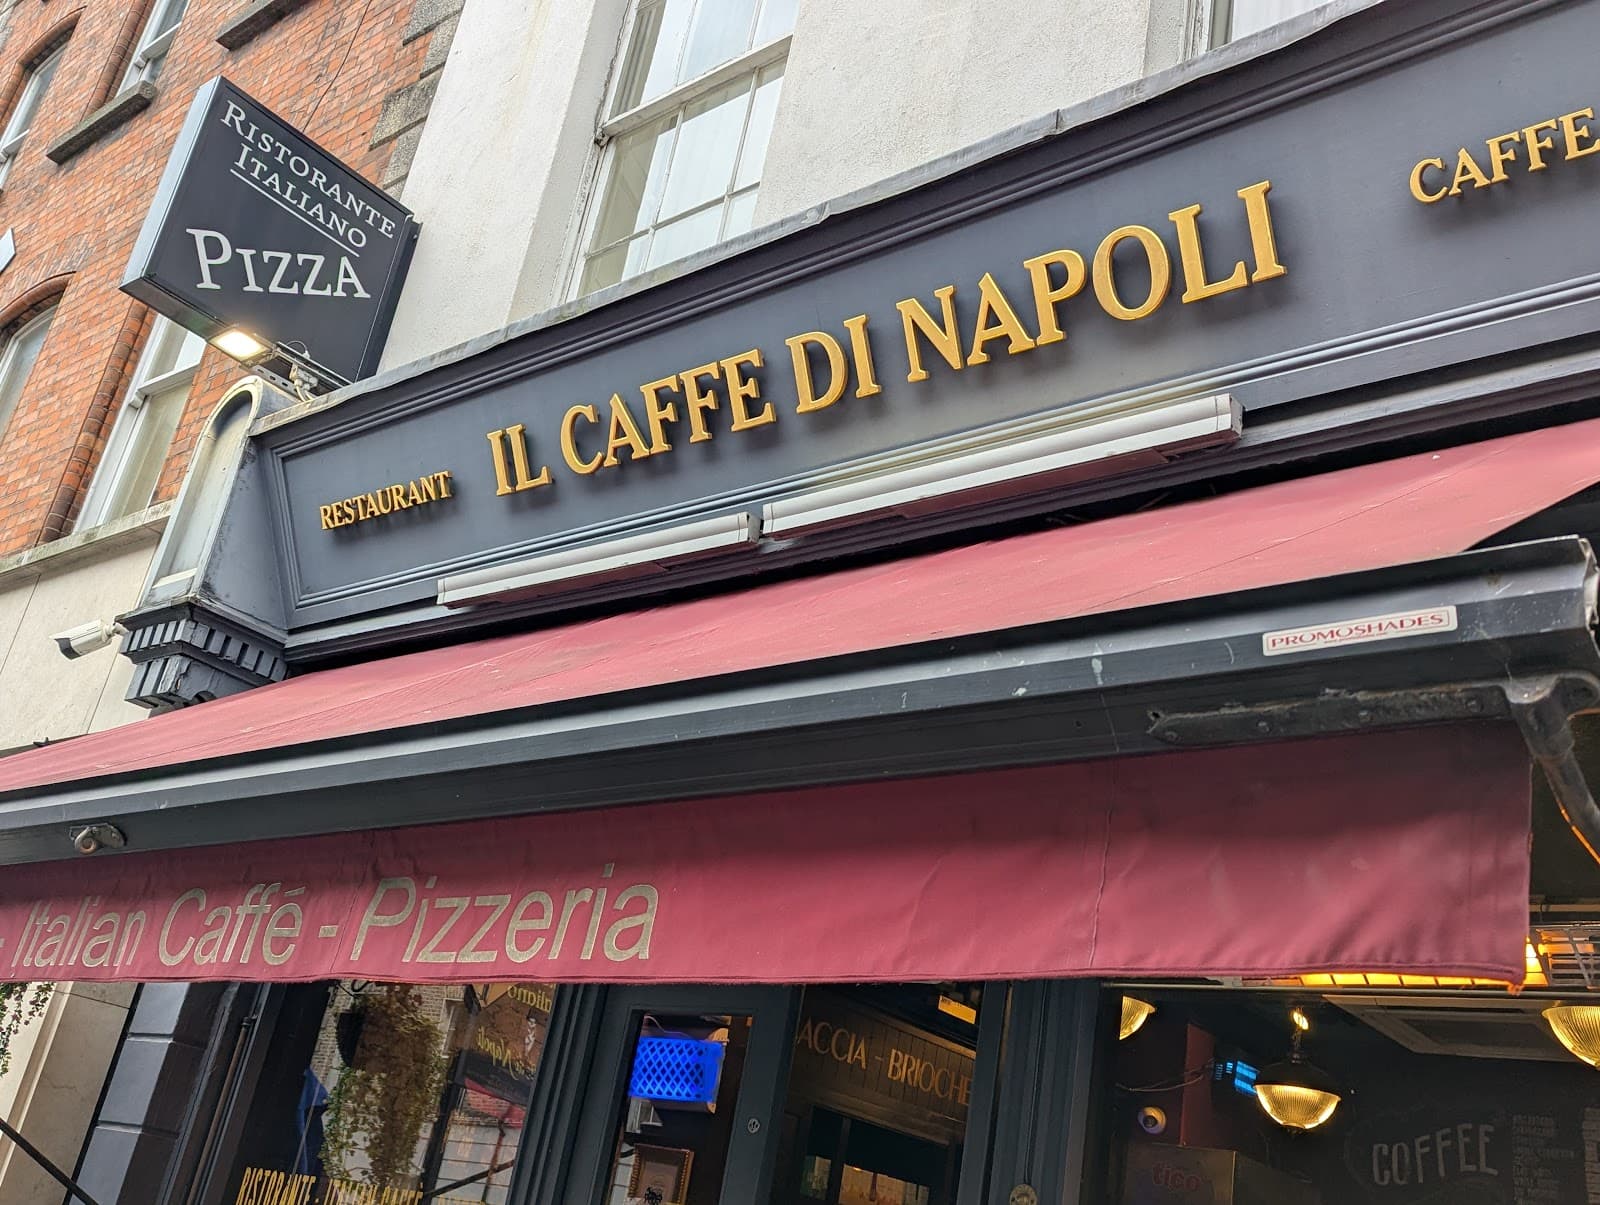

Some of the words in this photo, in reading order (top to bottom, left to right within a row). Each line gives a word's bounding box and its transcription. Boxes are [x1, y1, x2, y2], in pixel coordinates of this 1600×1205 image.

[220, 100, 396, 239] RISTORANTE
[234, 143, 367, 248] ITALIANO
[1409, 107, 1600, 204] CAFFE
[186, 228, 371, 298] PIZZA
[487, 423, 552, 496] IL
[560, 348, 776, 475] CAFFE
[785, 313, 882, 415] DI
[896, 180, 1288, 383] NAPOLI
[319, 470, 453, 531] RESTAURANT
[1271, 613, 1444, 649] PROMOSHADES
[11, 896, 147, 968] Italian
[158, 883, 306, 968] Caffé
[350, 863, 660, 964] Pizzeria
[1372, 1123, 1499, 1186] COFFEE
